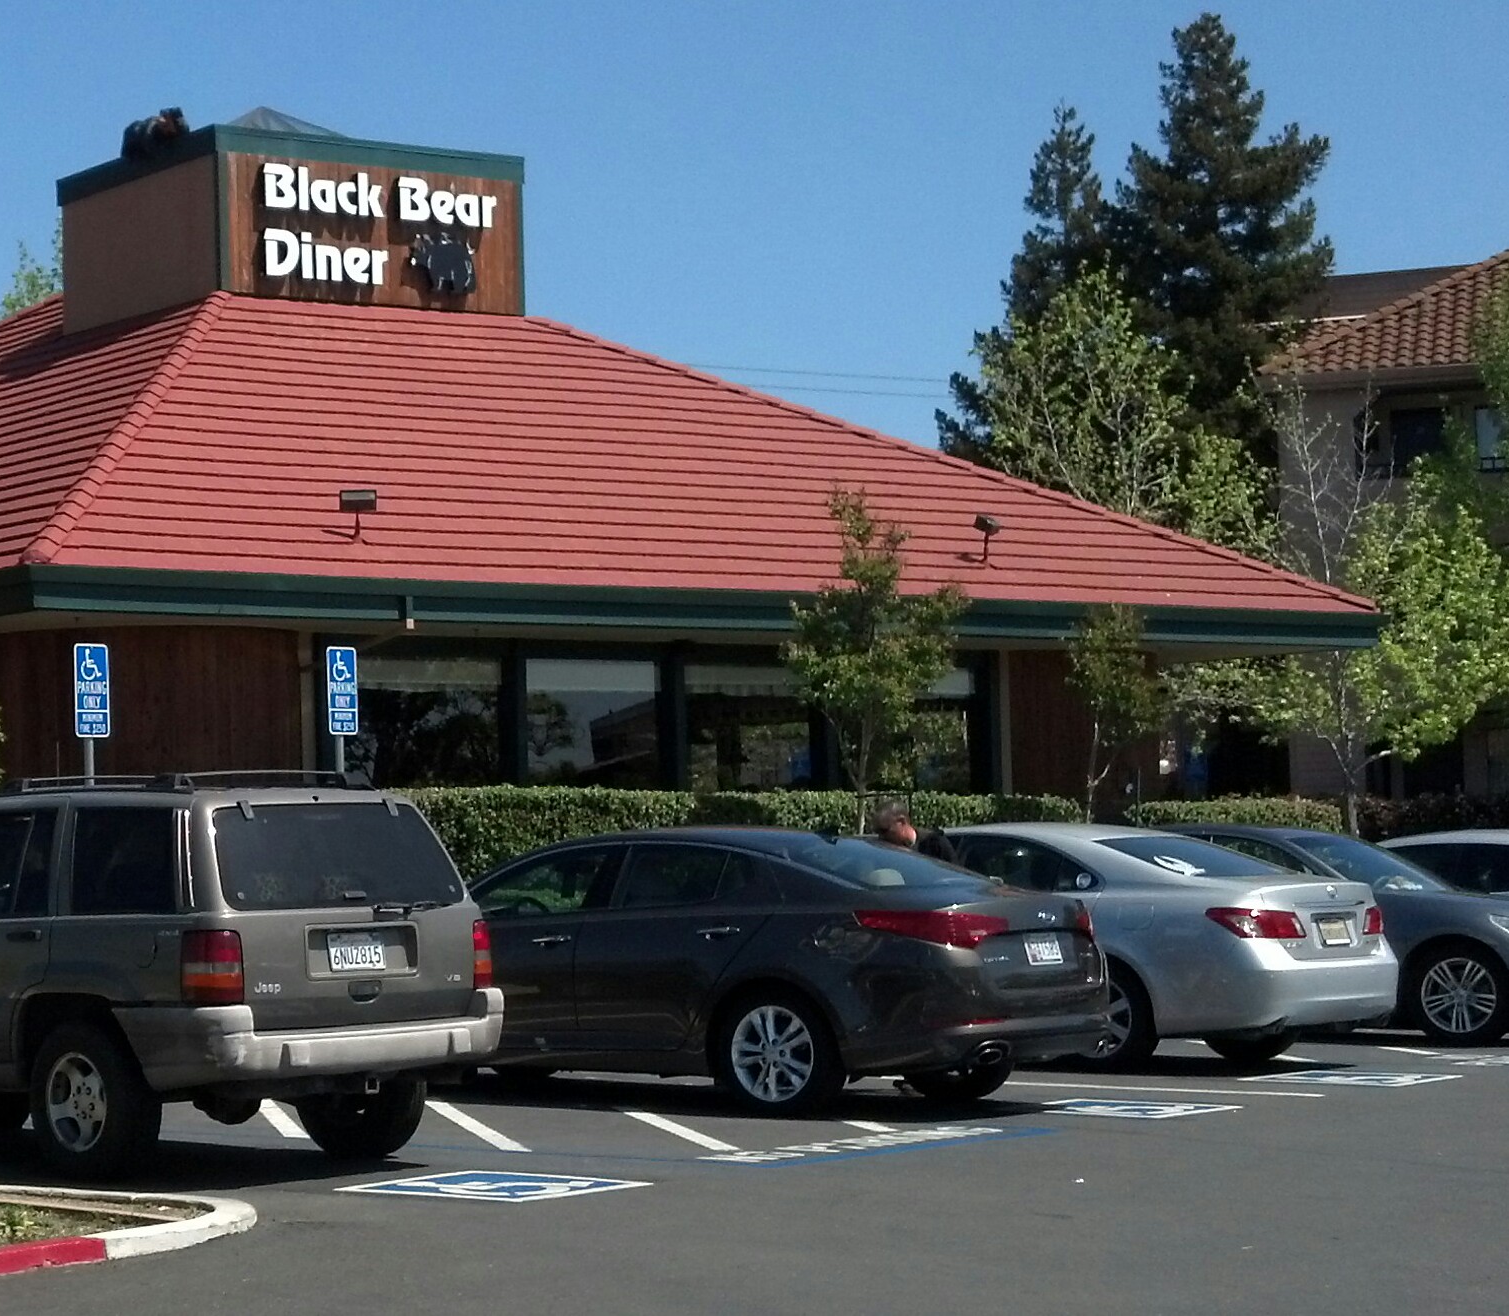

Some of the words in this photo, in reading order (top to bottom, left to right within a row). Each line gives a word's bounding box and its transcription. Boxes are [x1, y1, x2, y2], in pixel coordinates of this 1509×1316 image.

[263, 162, 385, 218] Black
[398, 176, 497, 228] Bear
[263, 227, 389, 285] Diner
[77, 681, 107, 695] PARKING
[83, 695, 101, 709] ONLY
[254, 981, 281, 994] Jeep
